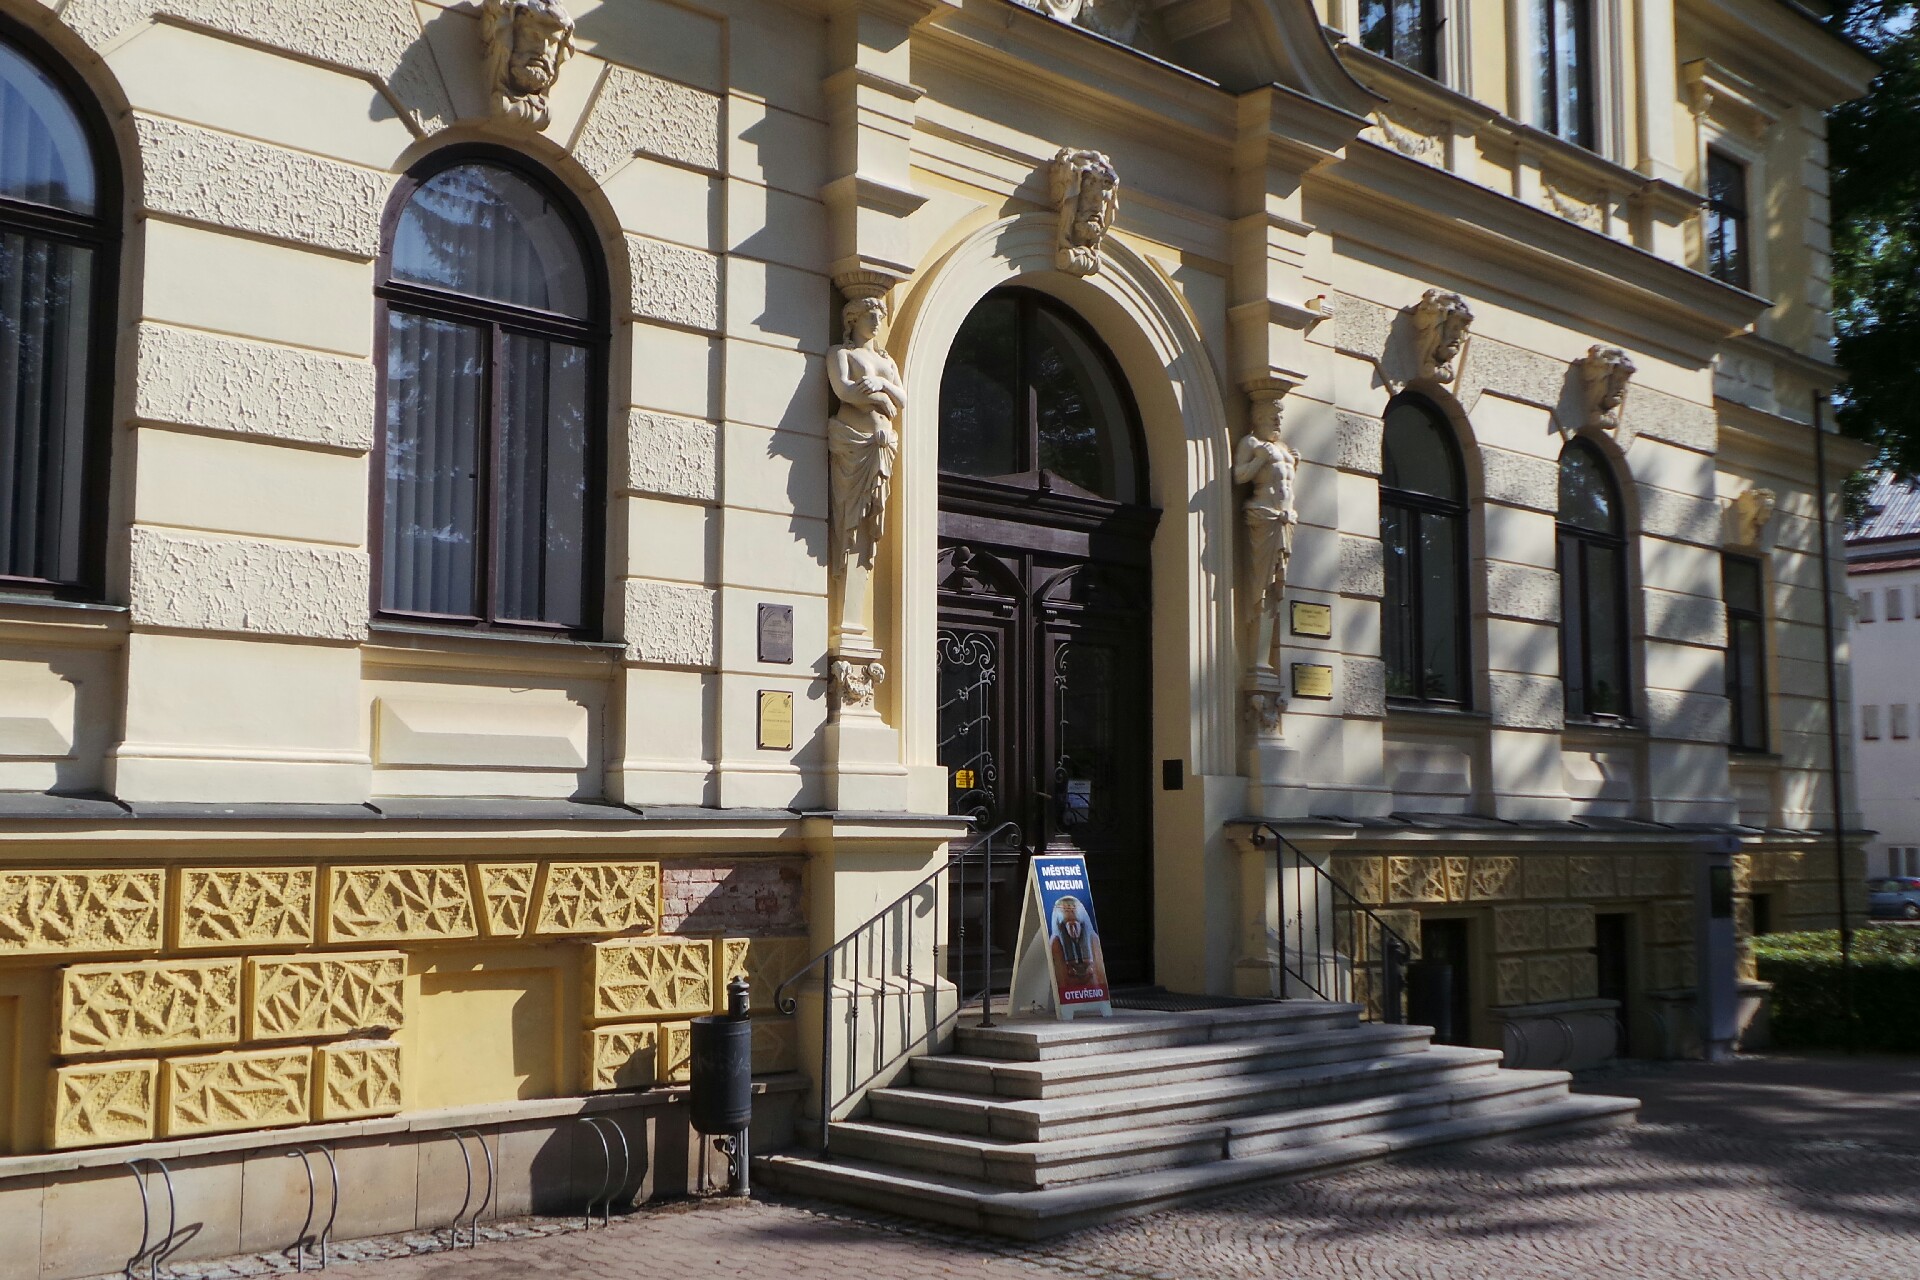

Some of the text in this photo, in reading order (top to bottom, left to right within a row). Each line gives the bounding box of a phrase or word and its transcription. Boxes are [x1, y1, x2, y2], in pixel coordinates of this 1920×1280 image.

[1041, 864, 1082, 876] MĚSTSKÉ
[1045, 879, 1083, 891] MUZEUM
[1064, 988, 1103, 1000] OTEVŘENO
